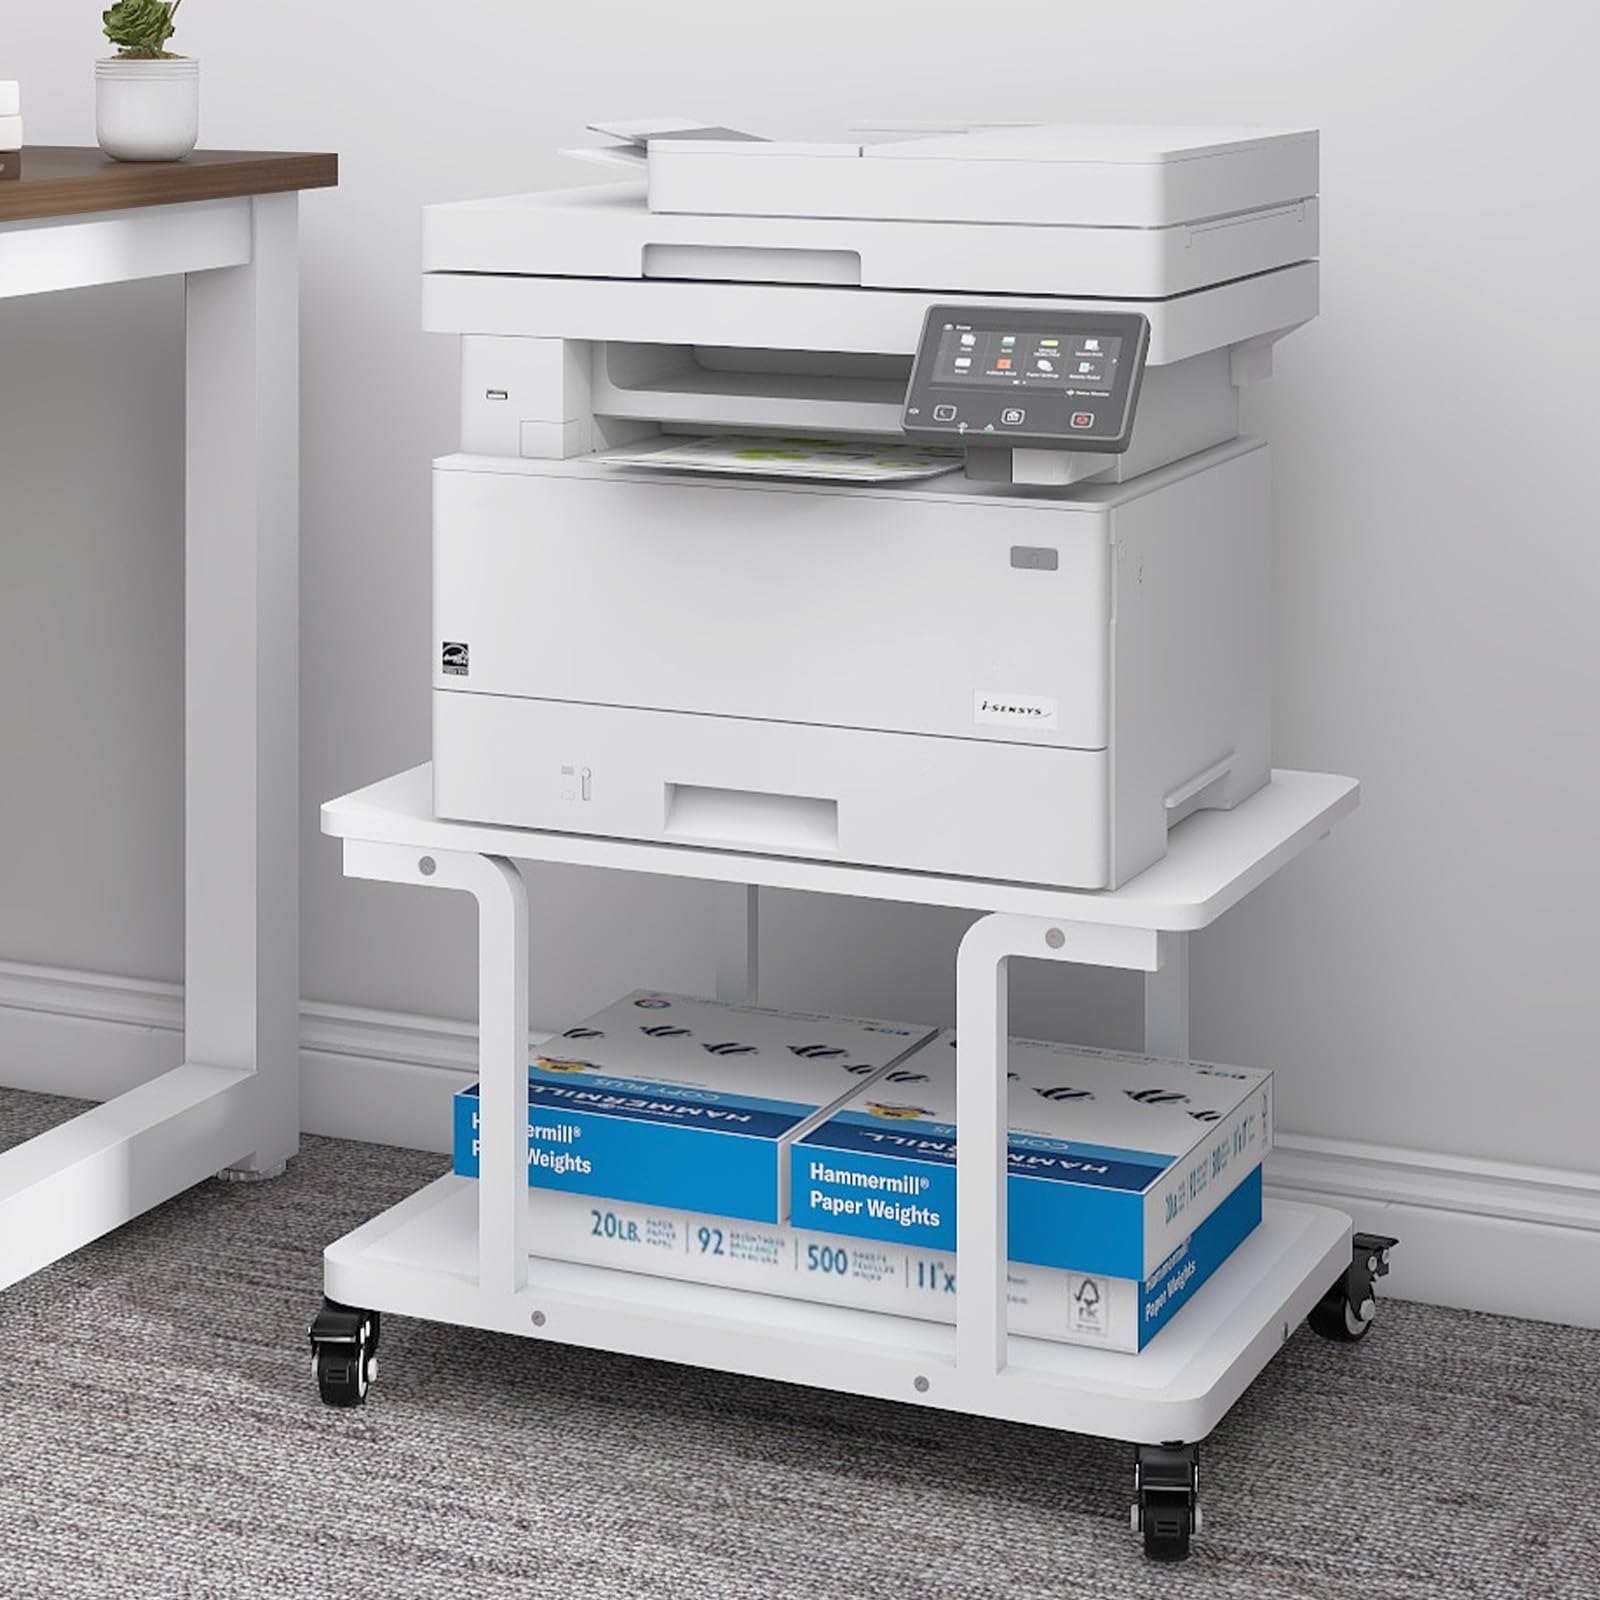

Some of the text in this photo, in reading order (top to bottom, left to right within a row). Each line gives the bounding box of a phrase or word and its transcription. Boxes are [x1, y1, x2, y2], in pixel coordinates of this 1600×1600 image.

[982, 701, 1042, 715] i-SENSYS
[594, 1078, 650, 1092] PLUS
[657, 1087, 721, 1102] COPY
[528, 1084, 752, 1123] HAMMERMILL
[810, 1162, 930, 1195] Hammermill®
[810, 1190, 940, 1227] Paper Weights
[591, 1209, 642, 1243] 20LB.
[698, 1226, 725, 1256] 92
[807, 1244, 848, 1276] 500
